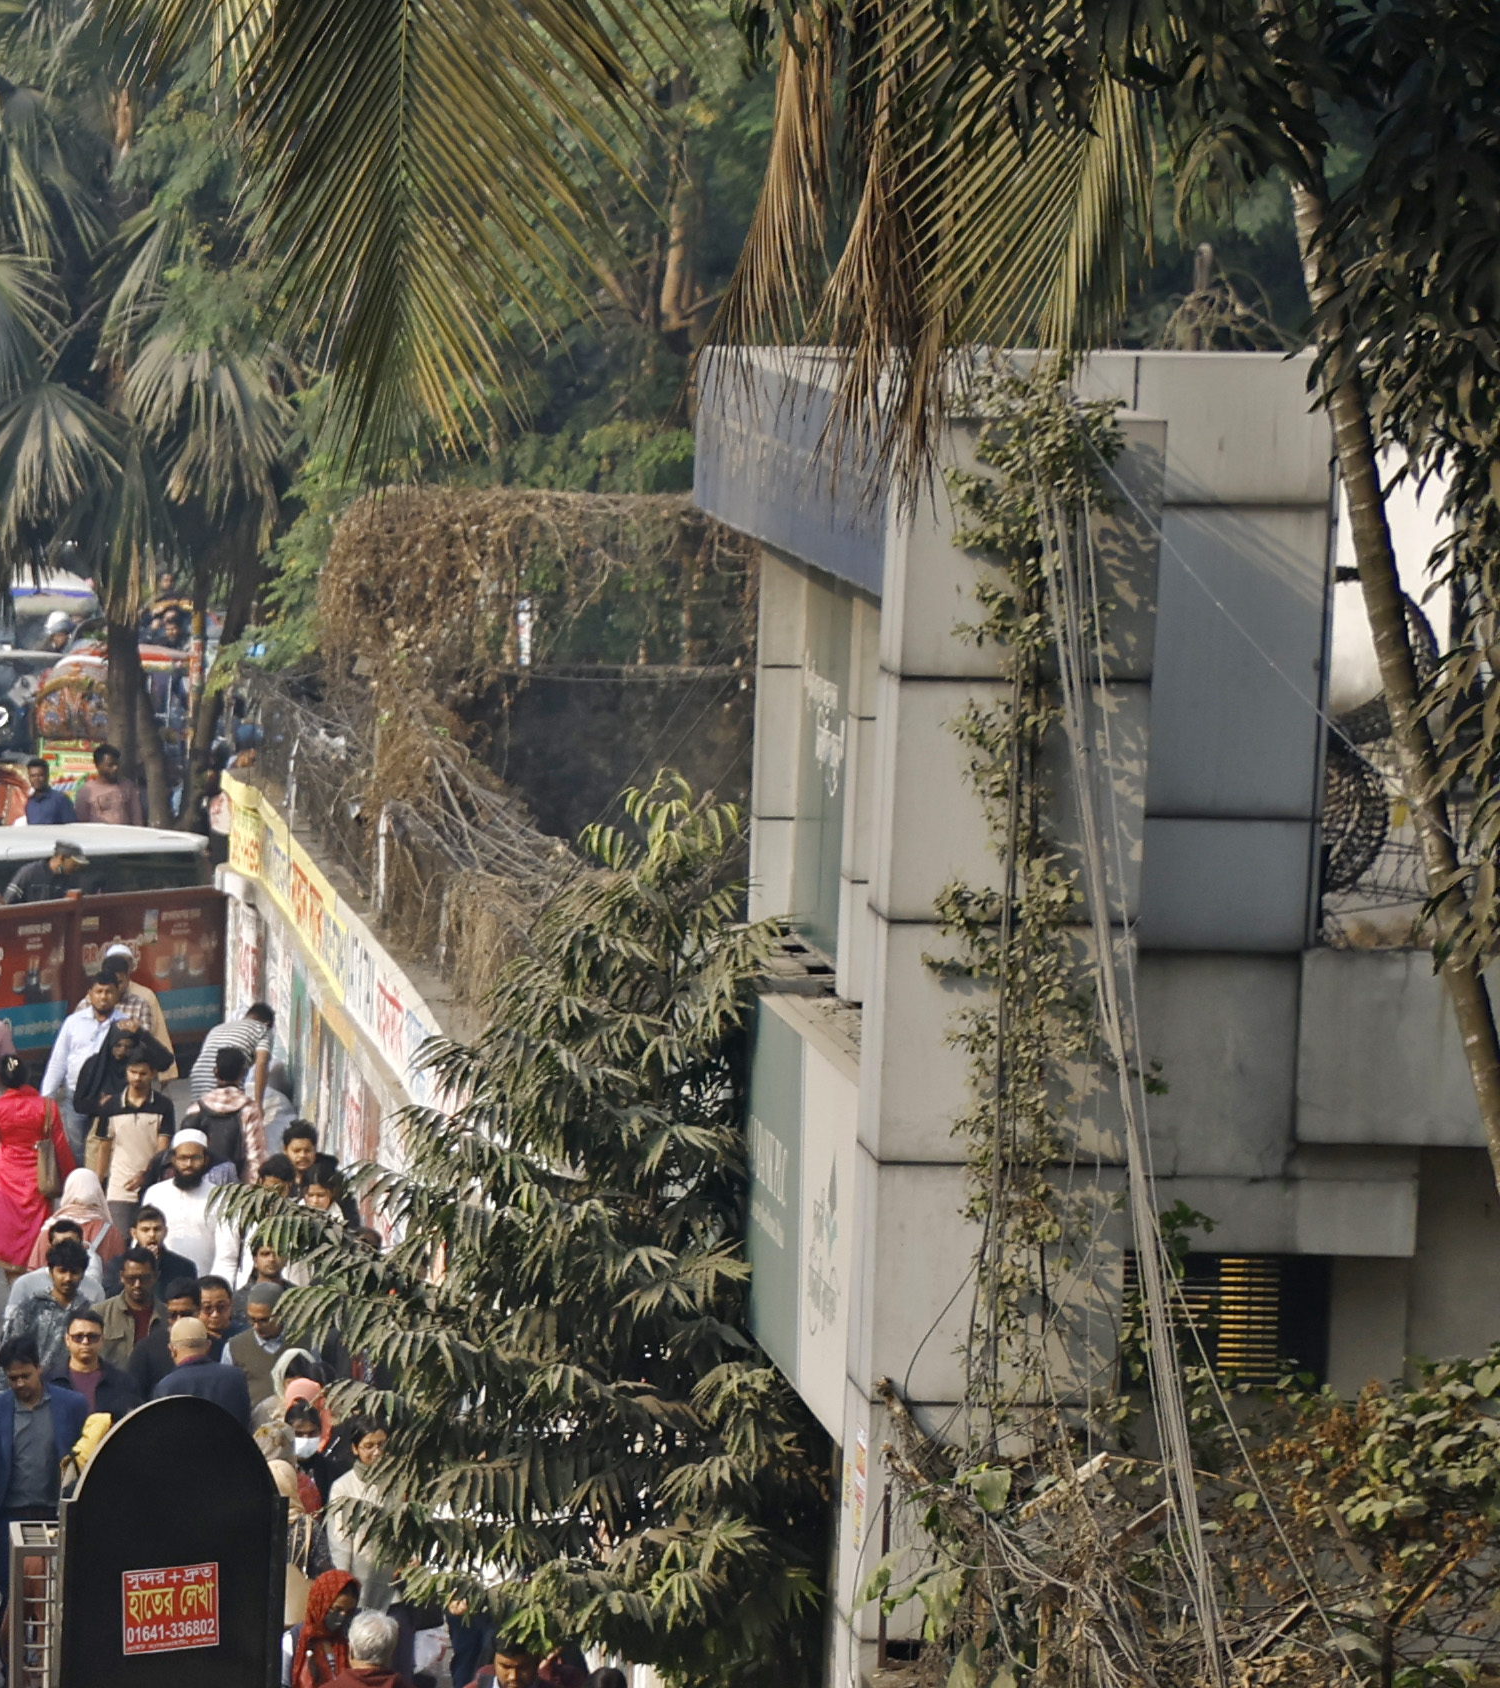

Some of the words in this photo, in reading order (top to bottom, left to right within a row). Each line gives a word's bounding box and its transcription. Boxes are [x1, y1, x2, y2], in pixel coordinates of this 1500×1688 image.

[126, 1571, 167, 1590] সুন্দর
[183, 1566, 214, 1582] দ্রুত
[127, 1587, 175, 1625] হাতের
[180, 1579, 215, 1616] লেখা
[126, 1618, 215, 1643] 01641-336802
